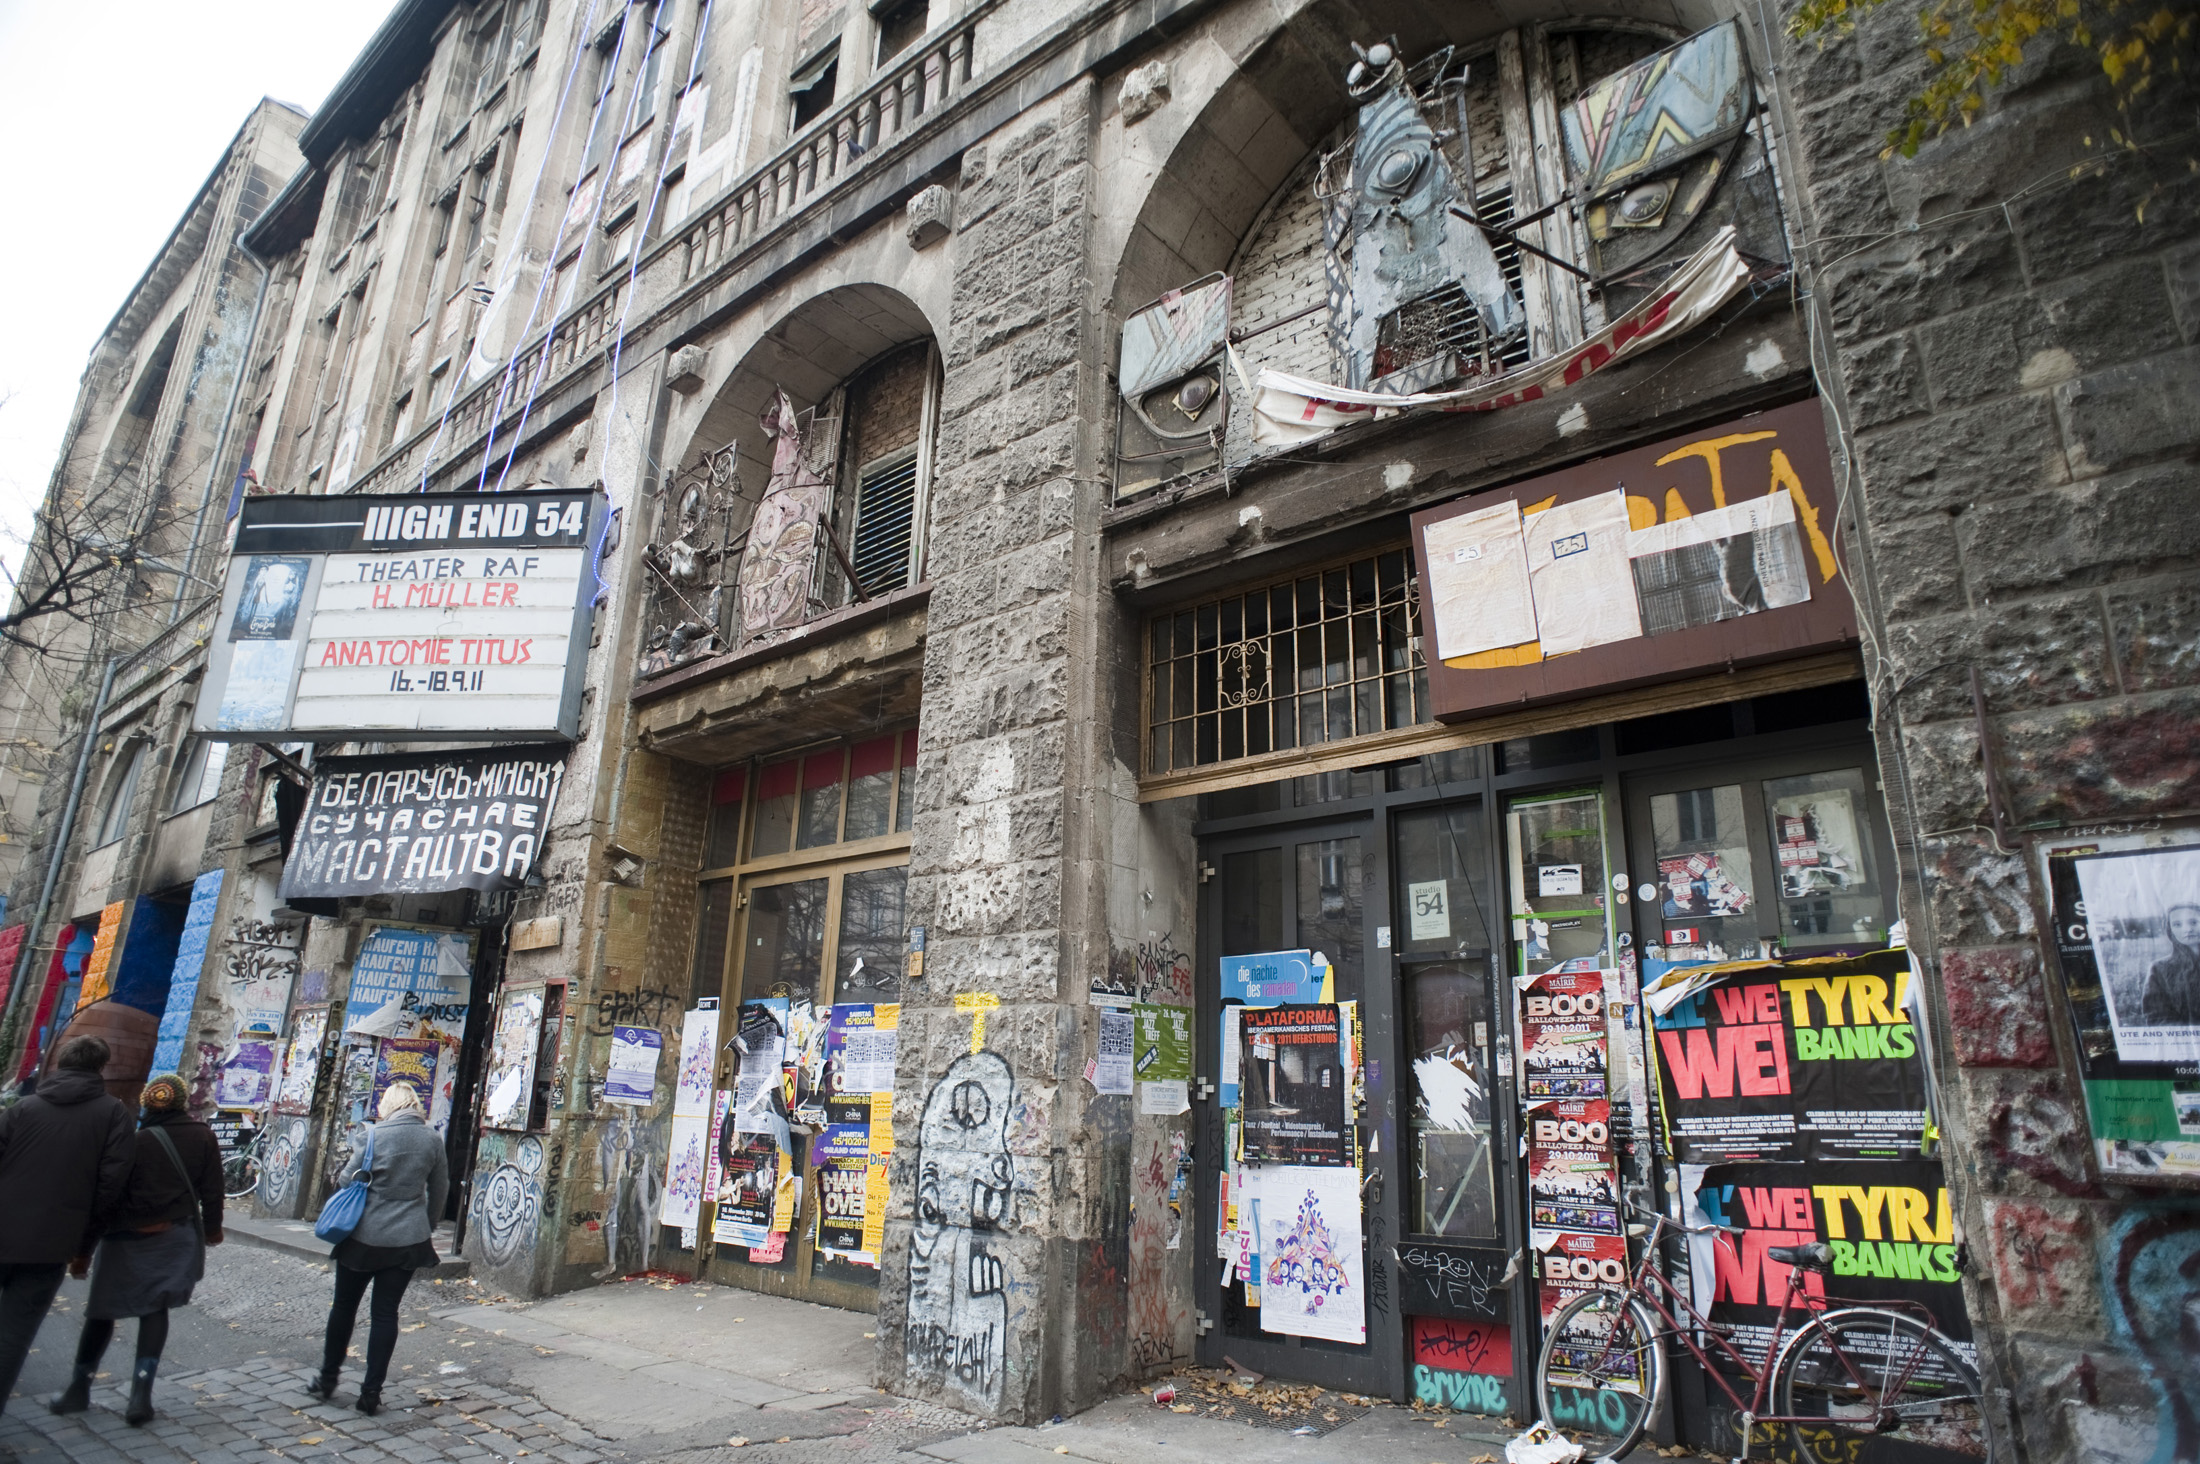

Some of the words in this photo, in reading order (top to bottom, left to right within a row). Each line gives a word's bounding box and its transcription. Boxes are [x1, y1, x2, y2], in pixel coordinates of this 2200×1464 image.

[458, 503, 529, 539] END
[535, 501, 584, 537] 54
[358, 557, 465, 582] THEATER
[483, 557, 540, 577] RAF
[372, 584, 395, 609] H.
[405, 582, 519, 608] MÜLLER
[320, 638, 454, 666] ANATOMIE
[460, 638, 534, 664] TITUS
[310, 801, 540, 835] СУЧАСНАЕ
[294, 828, 536, 884] МАСТАЦТВА
[1415, 886, 1441, 894] studio
[1415, 892, 1444, 917] 54
[360, 953, 416, 972] KAUFEN!
[355, 969, 412, 989] KAUFEN!
[1238, 965, 1250, 983] die
[1251, 964, 1278, 982] nächte
[1549, 977, 1576, 987] MATRIX
[1246, 981, 1261, 998] des
[1262, 979, 1297, 997] ramadan
[1526, 993, 1600, 1017] BOO
[1712, 983, 1782, 1026] WE
[849, 1010, 872, 1018] SAMSTAG
[1245, 1009, 1337, 1026] PLATAFORMA
[1142, 1018, 1156, 1030] JAZZ
[1172, 1019, 1185, 1031] JAZZ
[1540, 1023, 1591, 1034] 29.10.2011
[1145, 1029, 1160, 1041] TREFF
[1174, 1030, 1189, 1042] TREFF
[1277, 1034, 1292, 1045] 2011
[1292, 1033, 1338, 1045] UFERSTUDIOS
[1657, 1022, 1792, 1100] WE
[1558, 1103, 1586, 1113] MATRIX
[211, 1122, 225, 1131] DER
[228, 1130, 239, 1138] DES
[1244, 1121, 1257, 1129] Tanz
[1270, 1129, 1304, 1139] Performance
[1307, 1129, 1339, 1139] Installation
[1535, 1120, 1608, 1145] BOO
[823, 1146, 849, 1154] GRAND
[832, 1137, 868, 1146] 15/10/2011
[869, 1153, 887, 1167] Die
[880, 1151, 892, 1178] 7
[1548, 1150, 1600, 1162] 29.10.2011
[703, 1145, 720, 1202] design
[1738, 1187, 1816, 1230] WE
[1567, 1239, 1596, 1249] MATRIX
[1544, 1256, 1625, 1284] BOO
